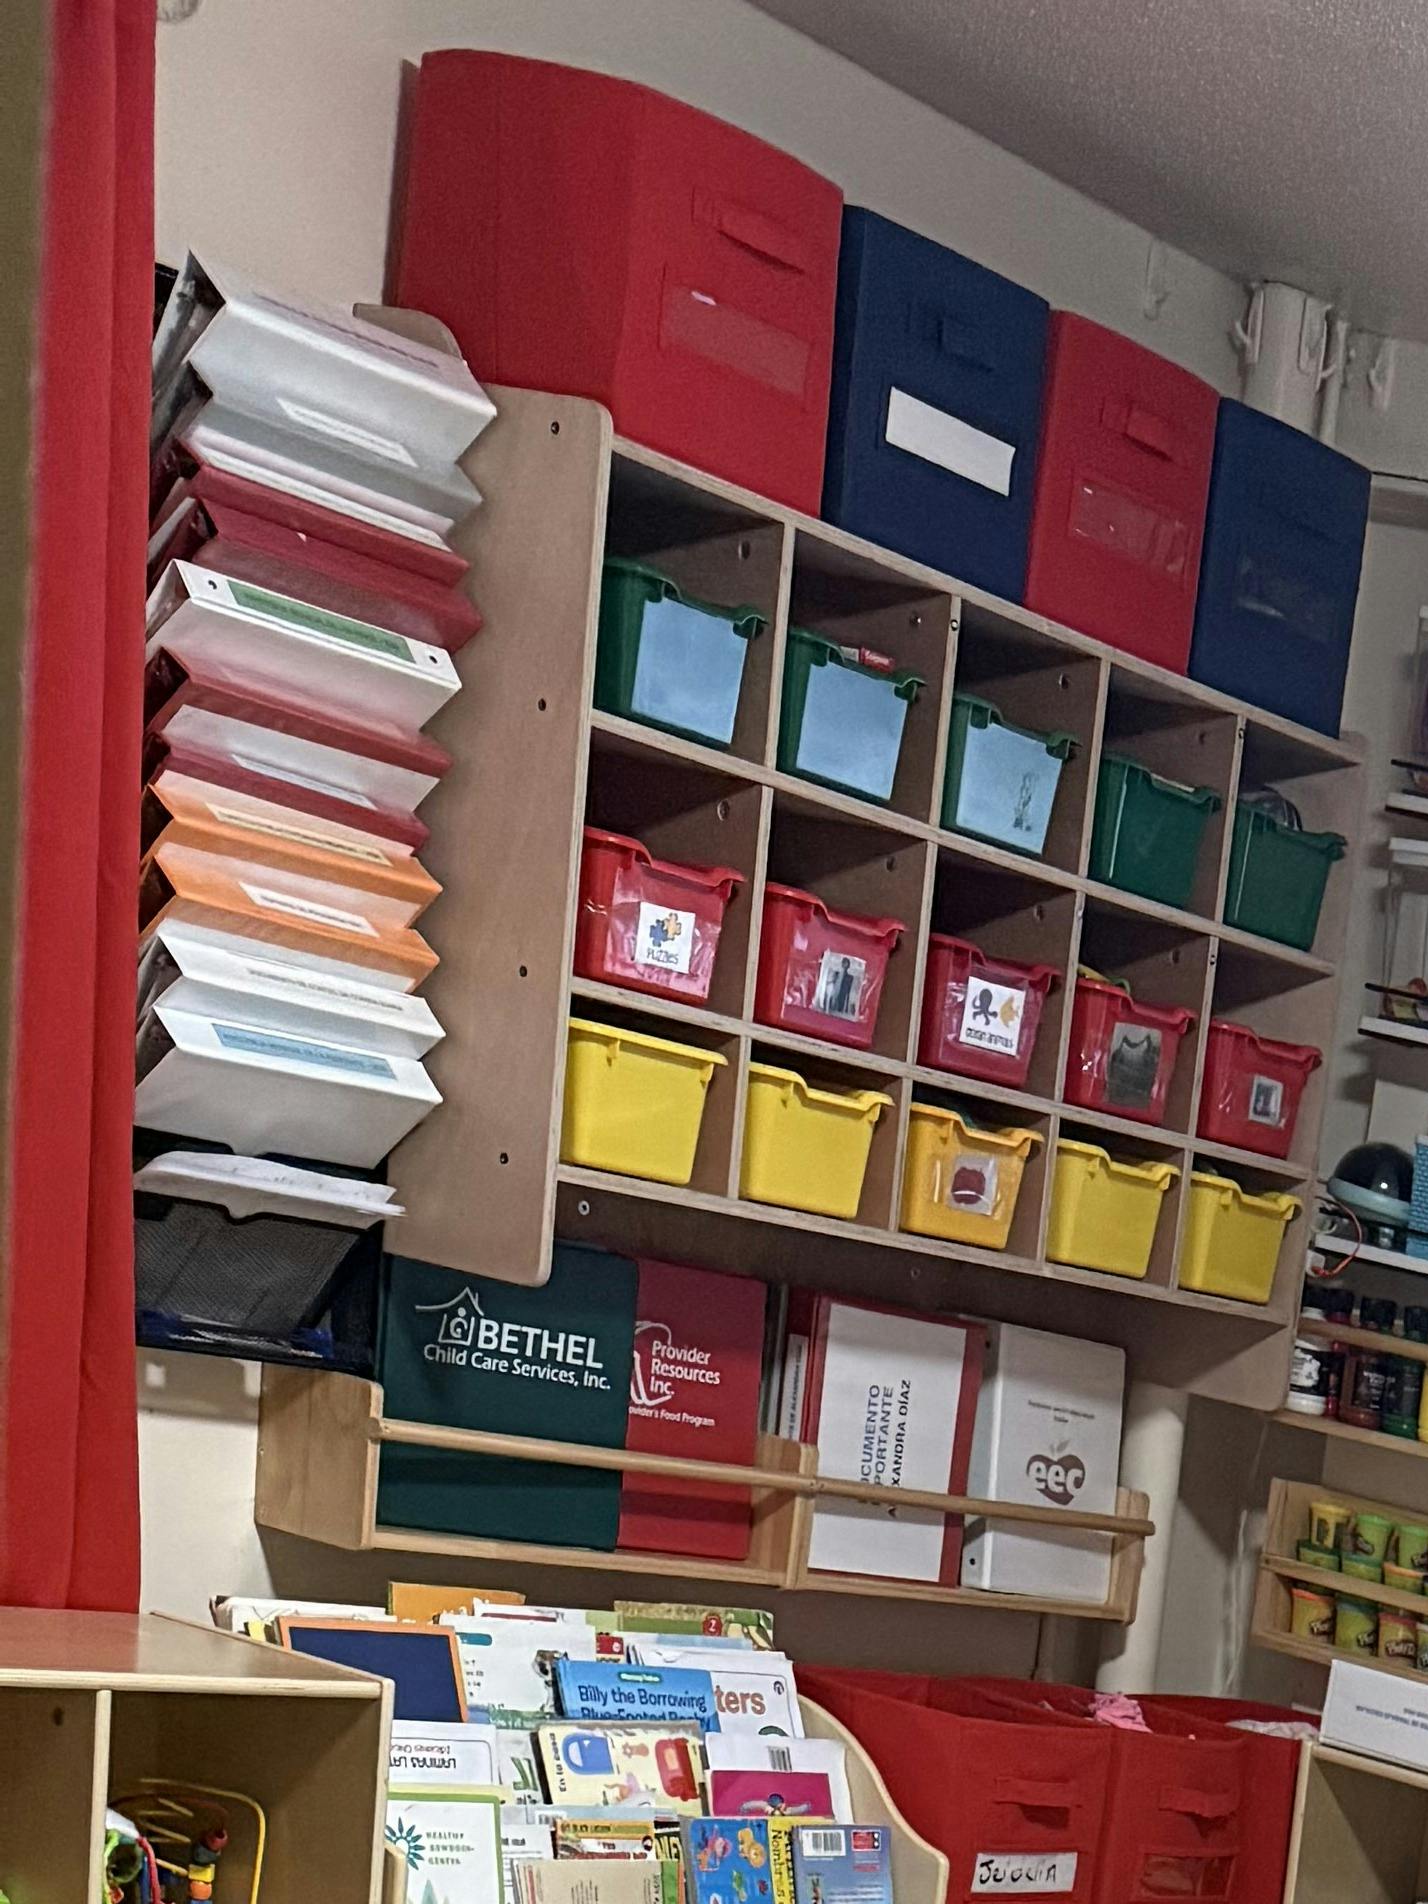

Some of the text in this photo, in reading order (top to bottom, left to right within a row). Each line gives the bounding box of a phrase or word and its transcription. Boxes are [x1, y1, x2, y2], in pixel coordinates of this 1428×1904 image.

[478, 1317, 604, 1369] BETHEL
[651, 1340, 711, 1366] Provider
[424, 1344, 611, 1390] Child Care Services, Inc.
[650, 1358, 721, 1385] Resources
[649, 1376, 675, 1396] Inc.
[898, 1379, 912, 1415] DÍAZ
[659, 1408, 716, 1428] Food Program
[860, 1384, 881, 1484] OCUMENTO
[873, 1386, 894, 1487] PORTANTE
[1029, 1460, 1083, 1494] eec
[578, 1685, 707, 1713] Billy the Borrowing
[714, 1685, 766, 1716] ters
